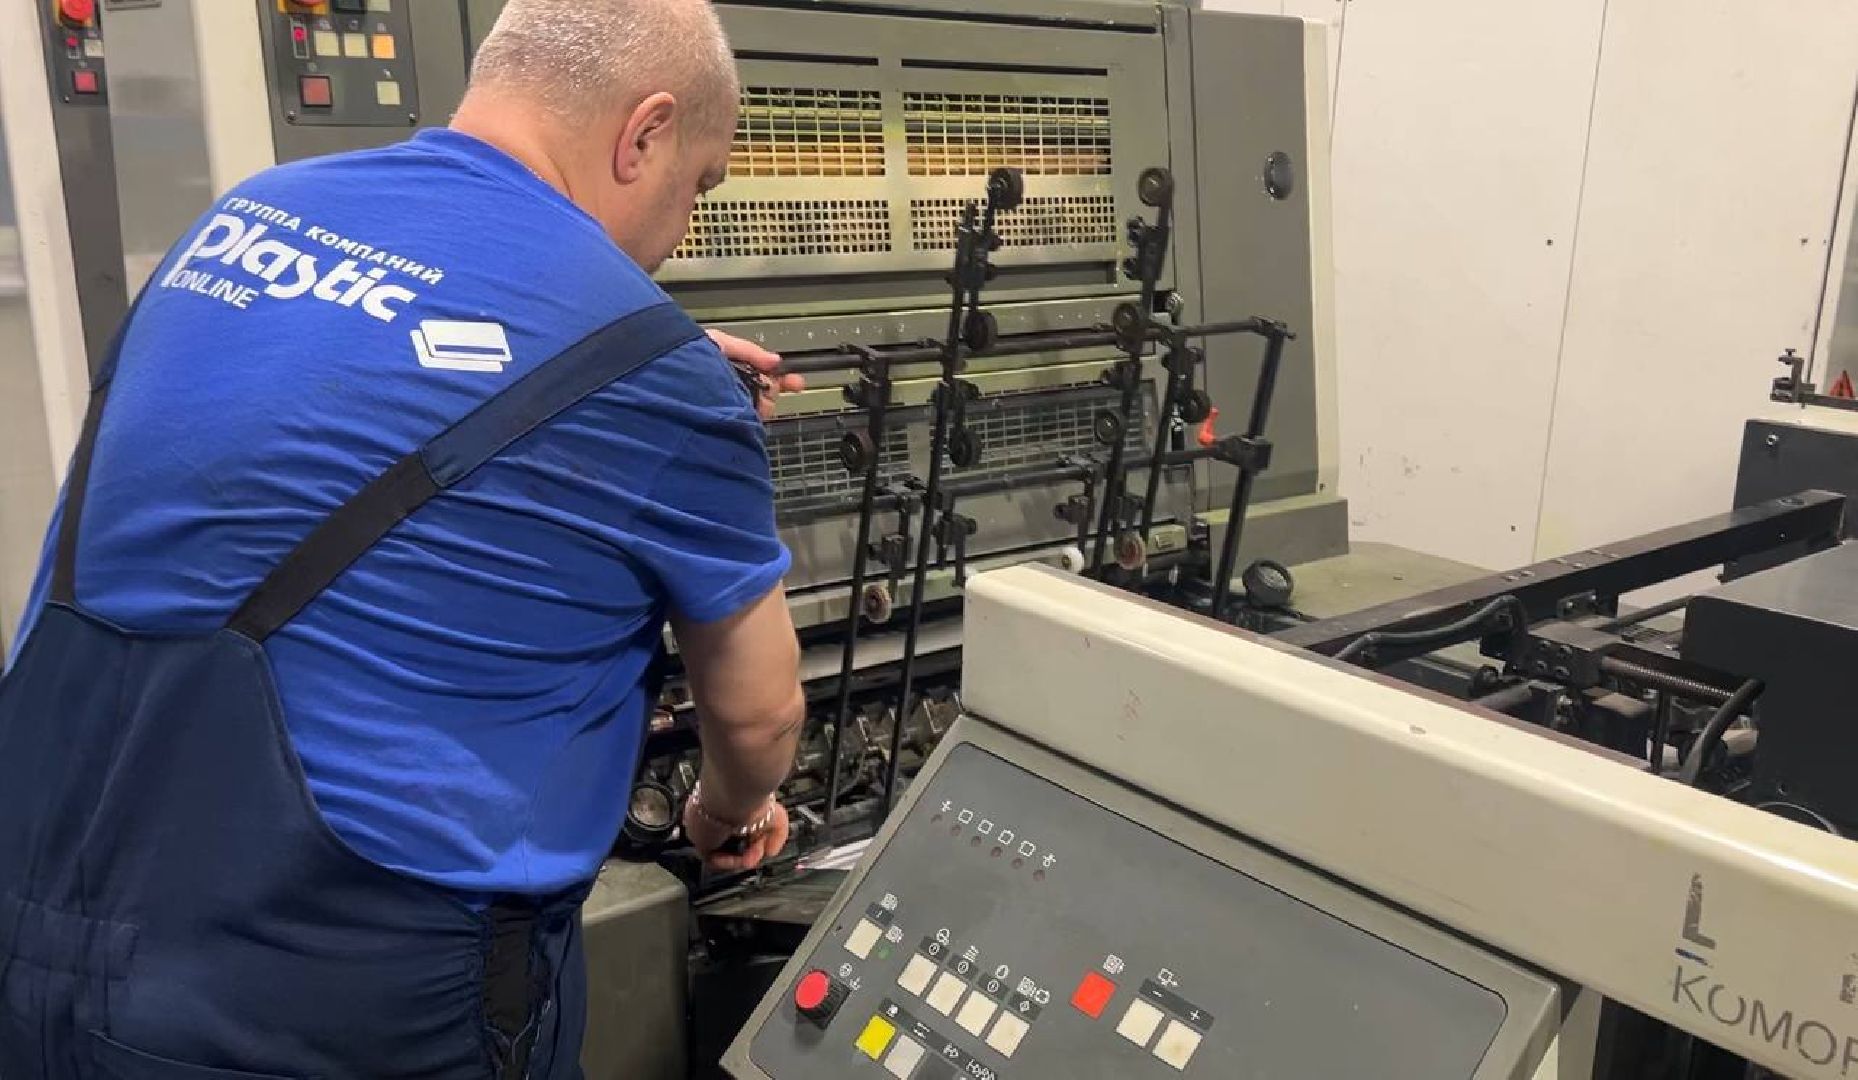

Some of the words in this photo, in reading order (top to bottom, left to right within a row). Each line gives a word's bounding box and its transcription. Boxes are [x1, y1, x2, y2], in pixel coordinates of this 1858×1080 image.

[222, 197, 302, 232] ГРУППА
[304, 225, 445, 285] КОМПАНИЙ
[173, 267, 260, 309] ONLINE
